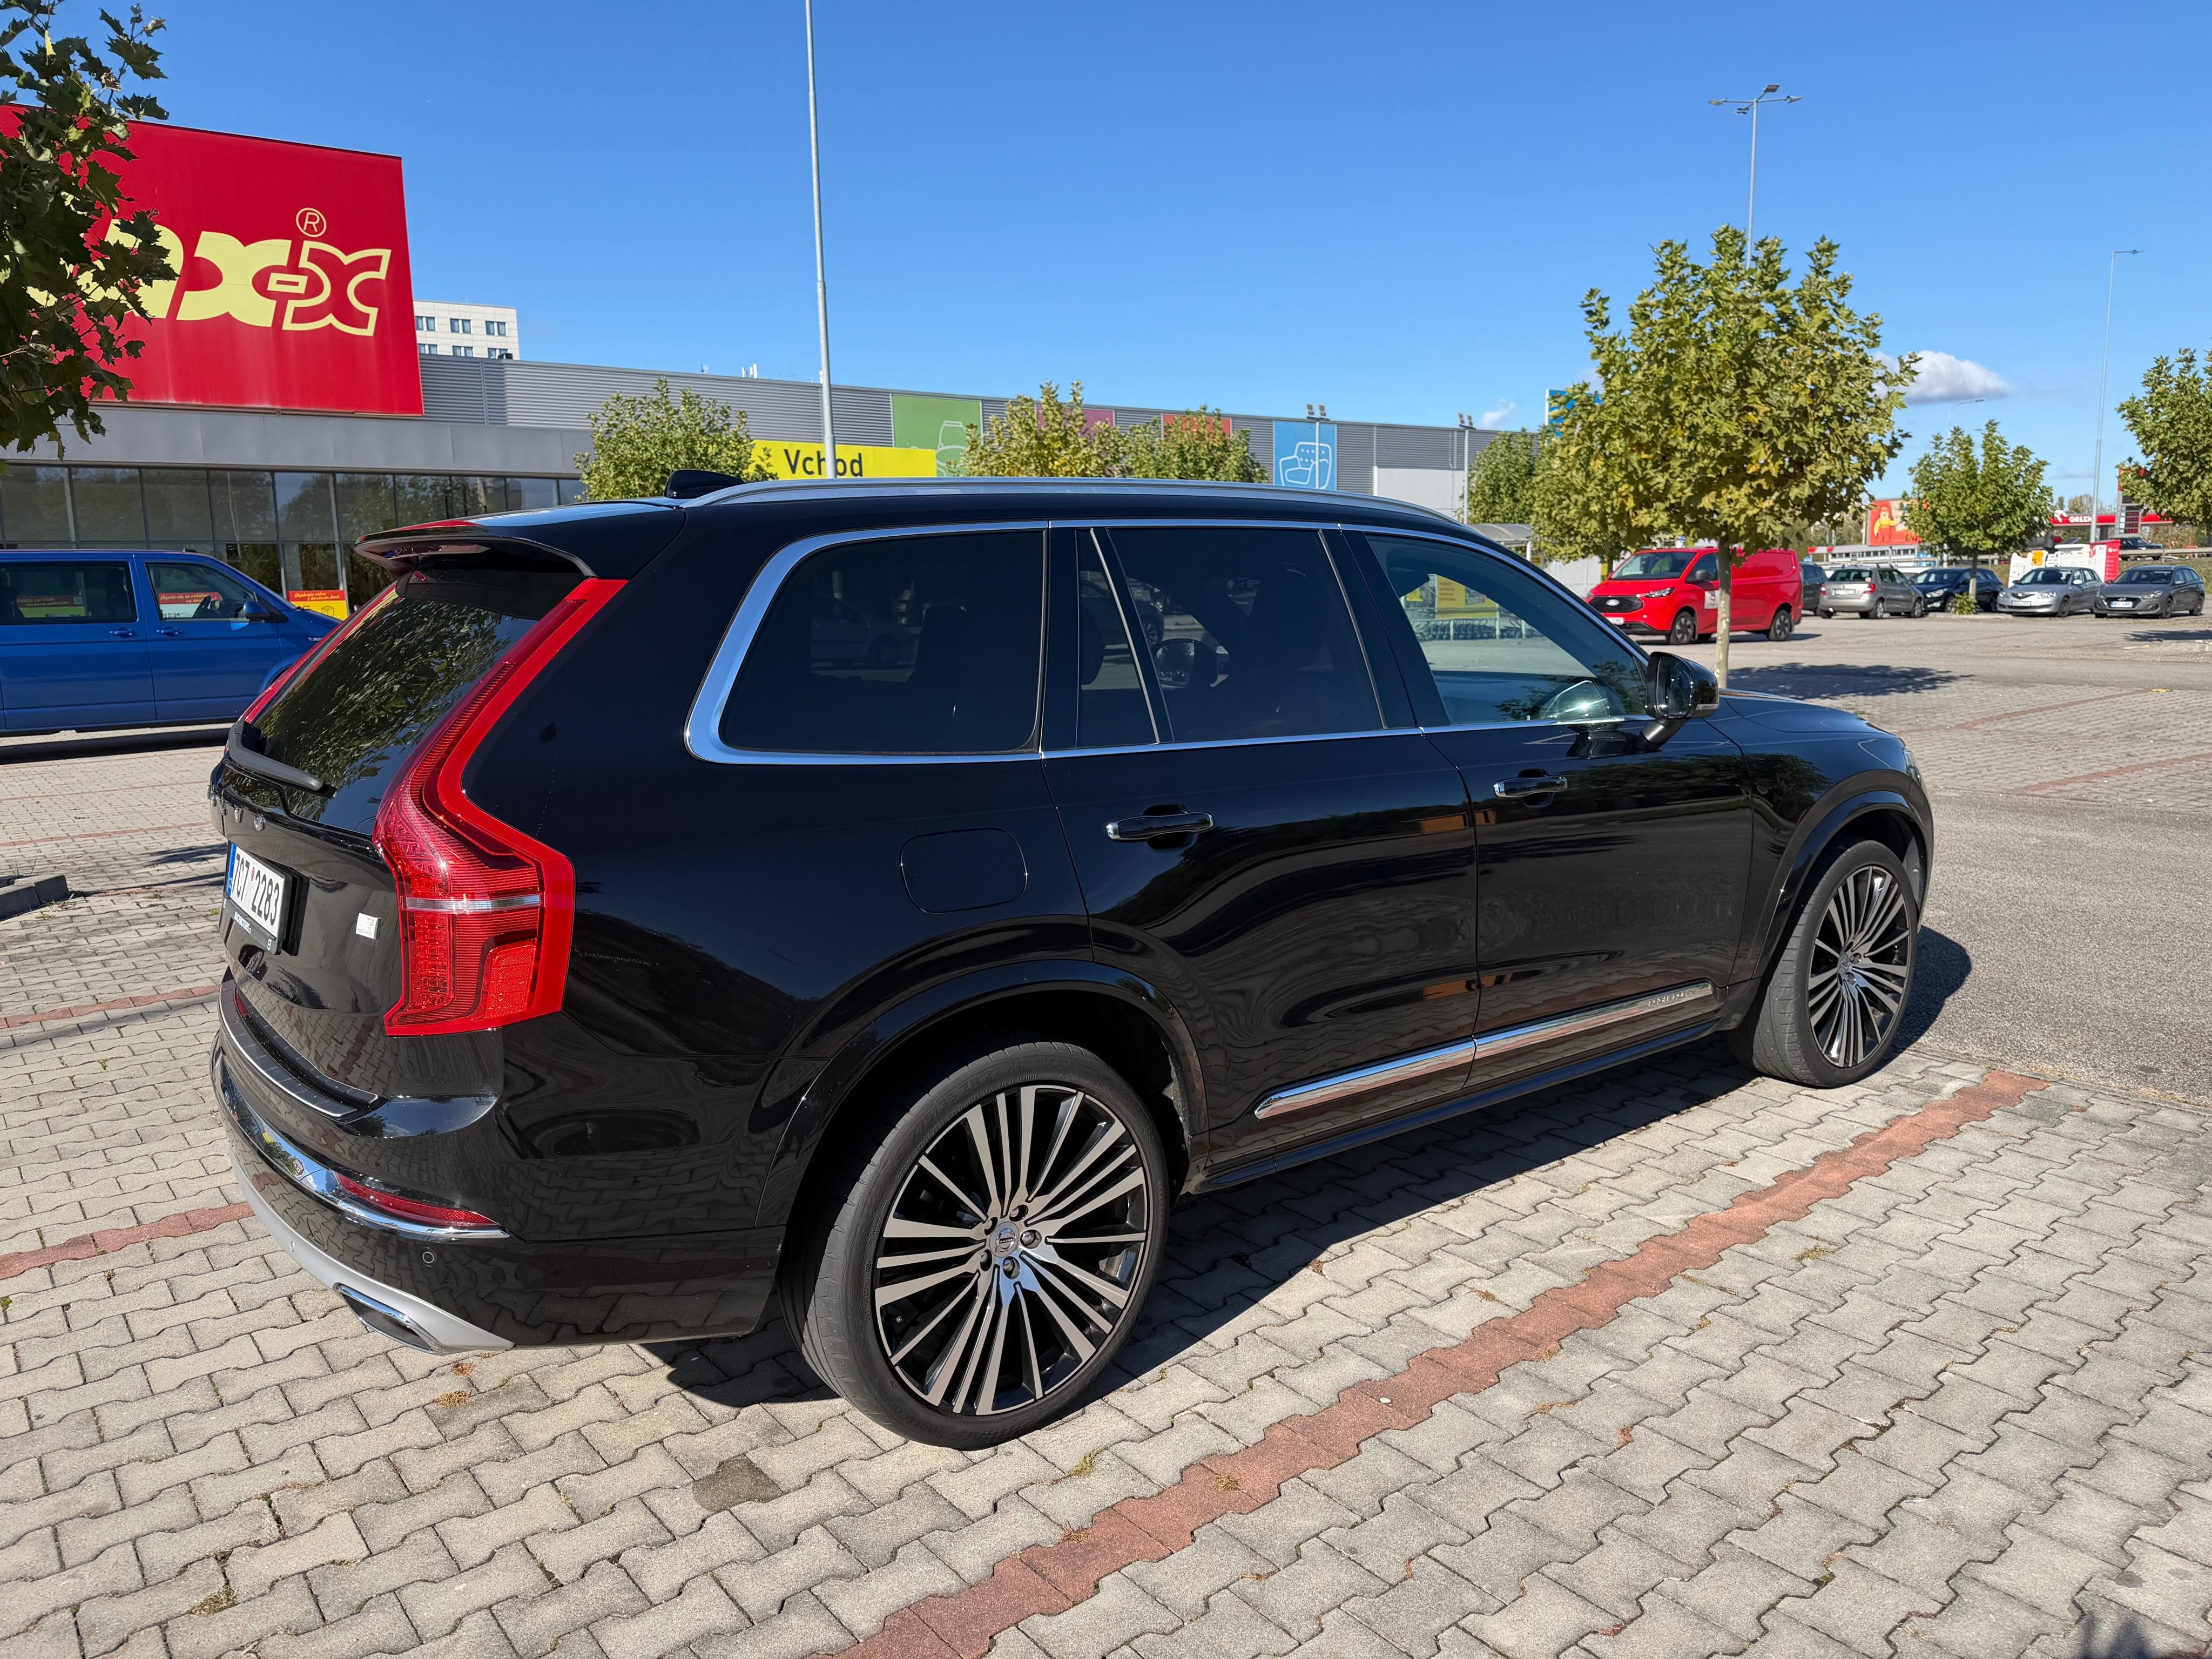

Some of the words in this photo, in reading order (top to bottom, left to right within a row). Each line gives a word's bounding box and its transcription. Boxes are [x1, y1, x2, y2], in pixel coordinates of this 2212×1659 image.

[784, 449, 863, 477] Vchod
[232, 854, 249, 901] 7C7
[251, 869, 279, 926] 2283
